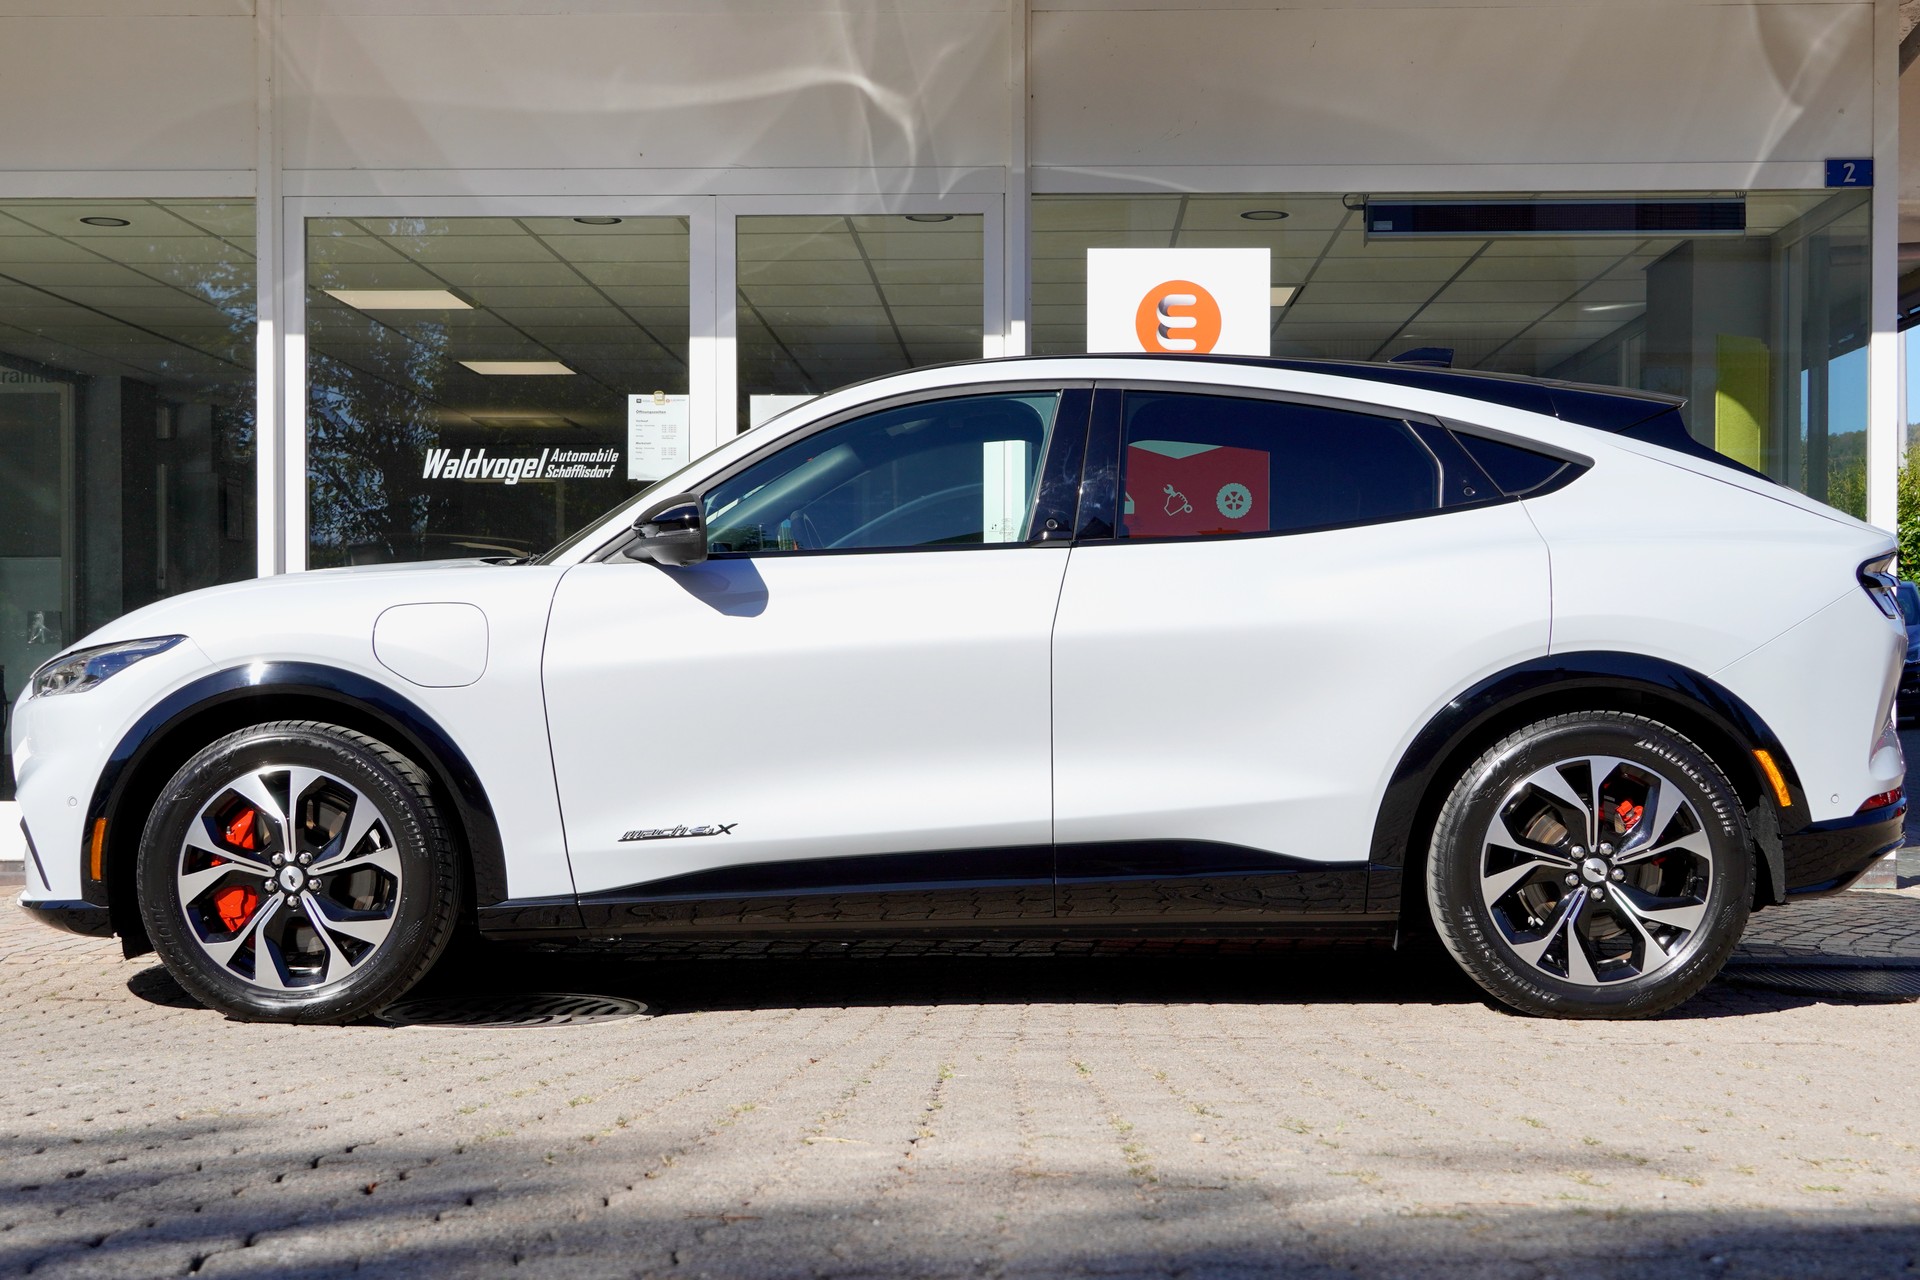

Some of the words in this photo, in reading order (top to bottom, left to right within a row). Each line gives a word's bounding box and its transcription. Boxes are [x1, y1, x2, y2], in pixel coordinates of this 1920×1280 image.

[1843, 162, 1857, 183] 2
[422, 448, 549, 485] Waldvogel
[550, 448, 619, 463] Automobile
[545, 464, 615, 479] Schöfflisdorf
